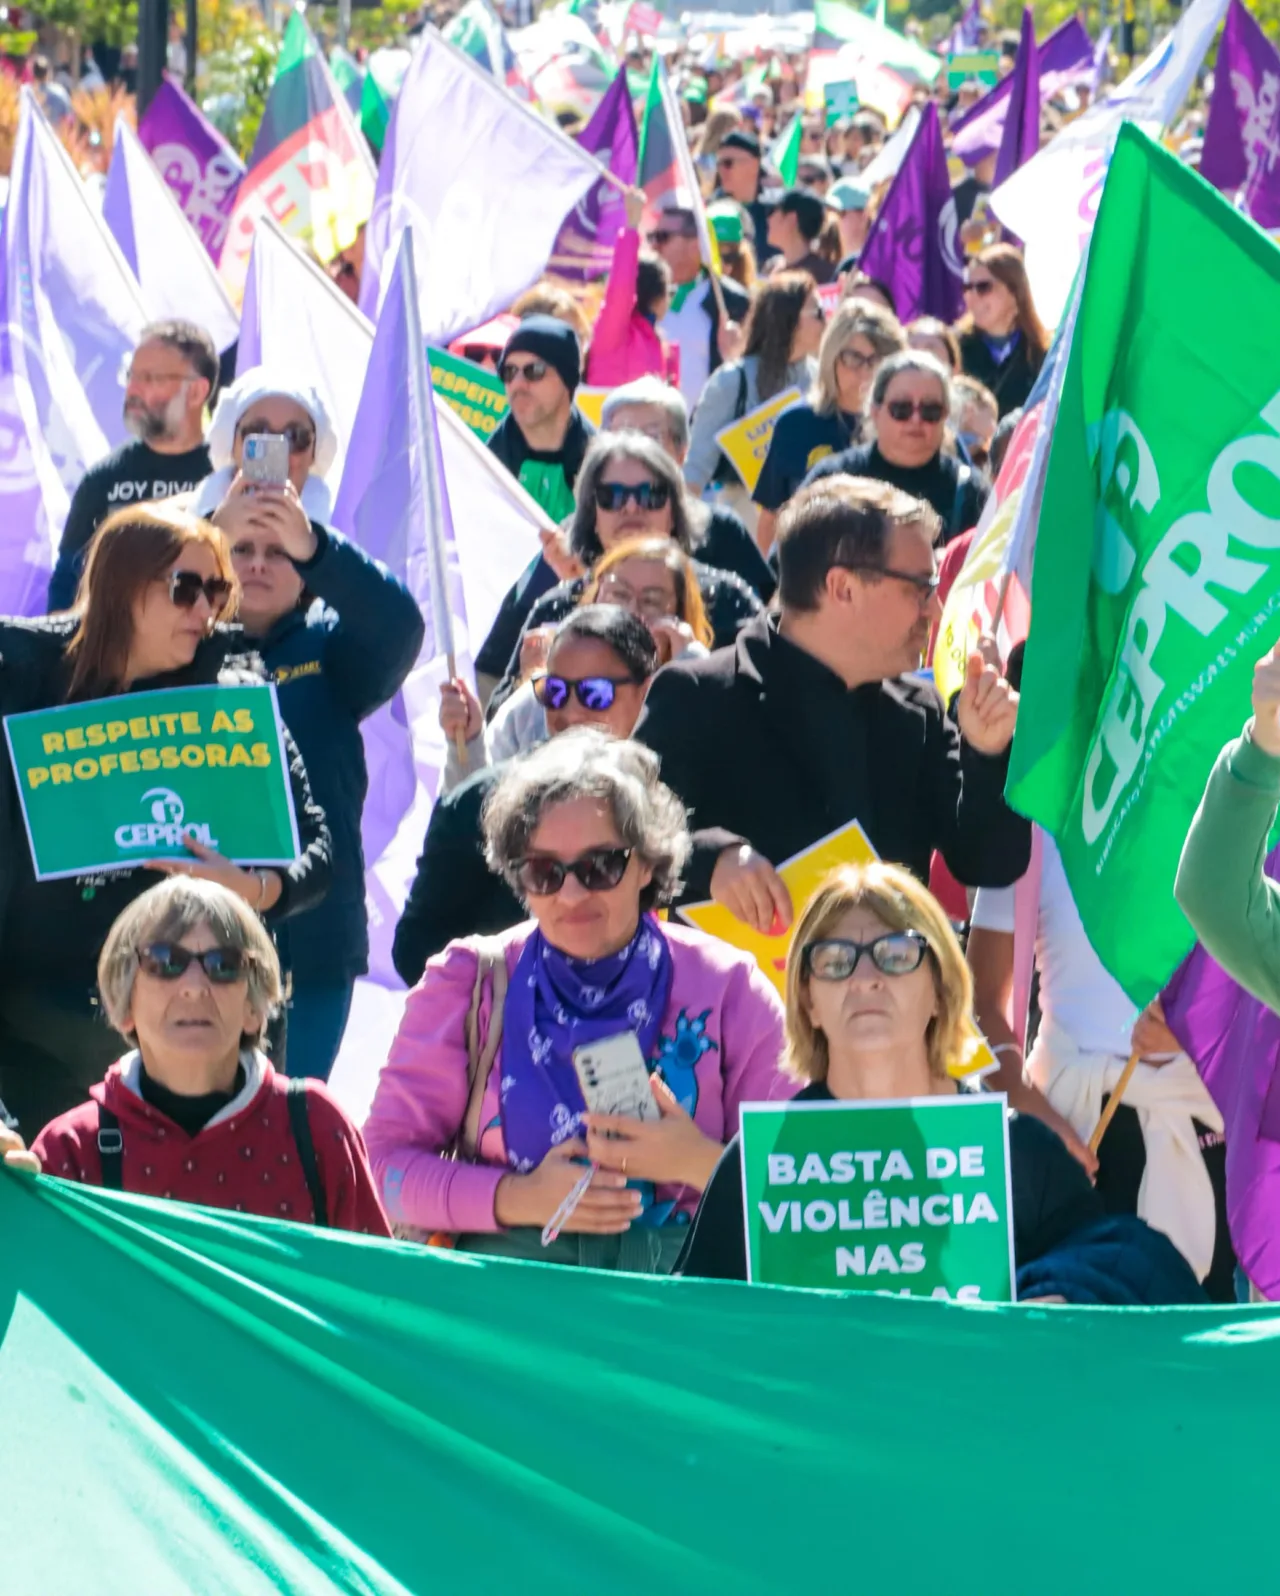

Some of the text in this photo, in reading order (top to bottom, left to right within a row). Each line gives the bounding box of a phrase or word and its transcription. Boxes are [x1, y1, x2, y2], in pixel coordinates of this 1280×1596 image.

[431, 366, 507, 413] ESPEITE
[107, 481, 148, 502] JOY
[42, 708, 254, 755] RESPEITE AS
[27, 743, 272, 789] PROFESSORAS
[114, 823, 219, 849] CEPROL
[768, 1145, 985, 1186] BASTA DE
[758, 1189, 999, 1233] VIOLÊNCIA
[835, 1242, 927, 1277] NAS
